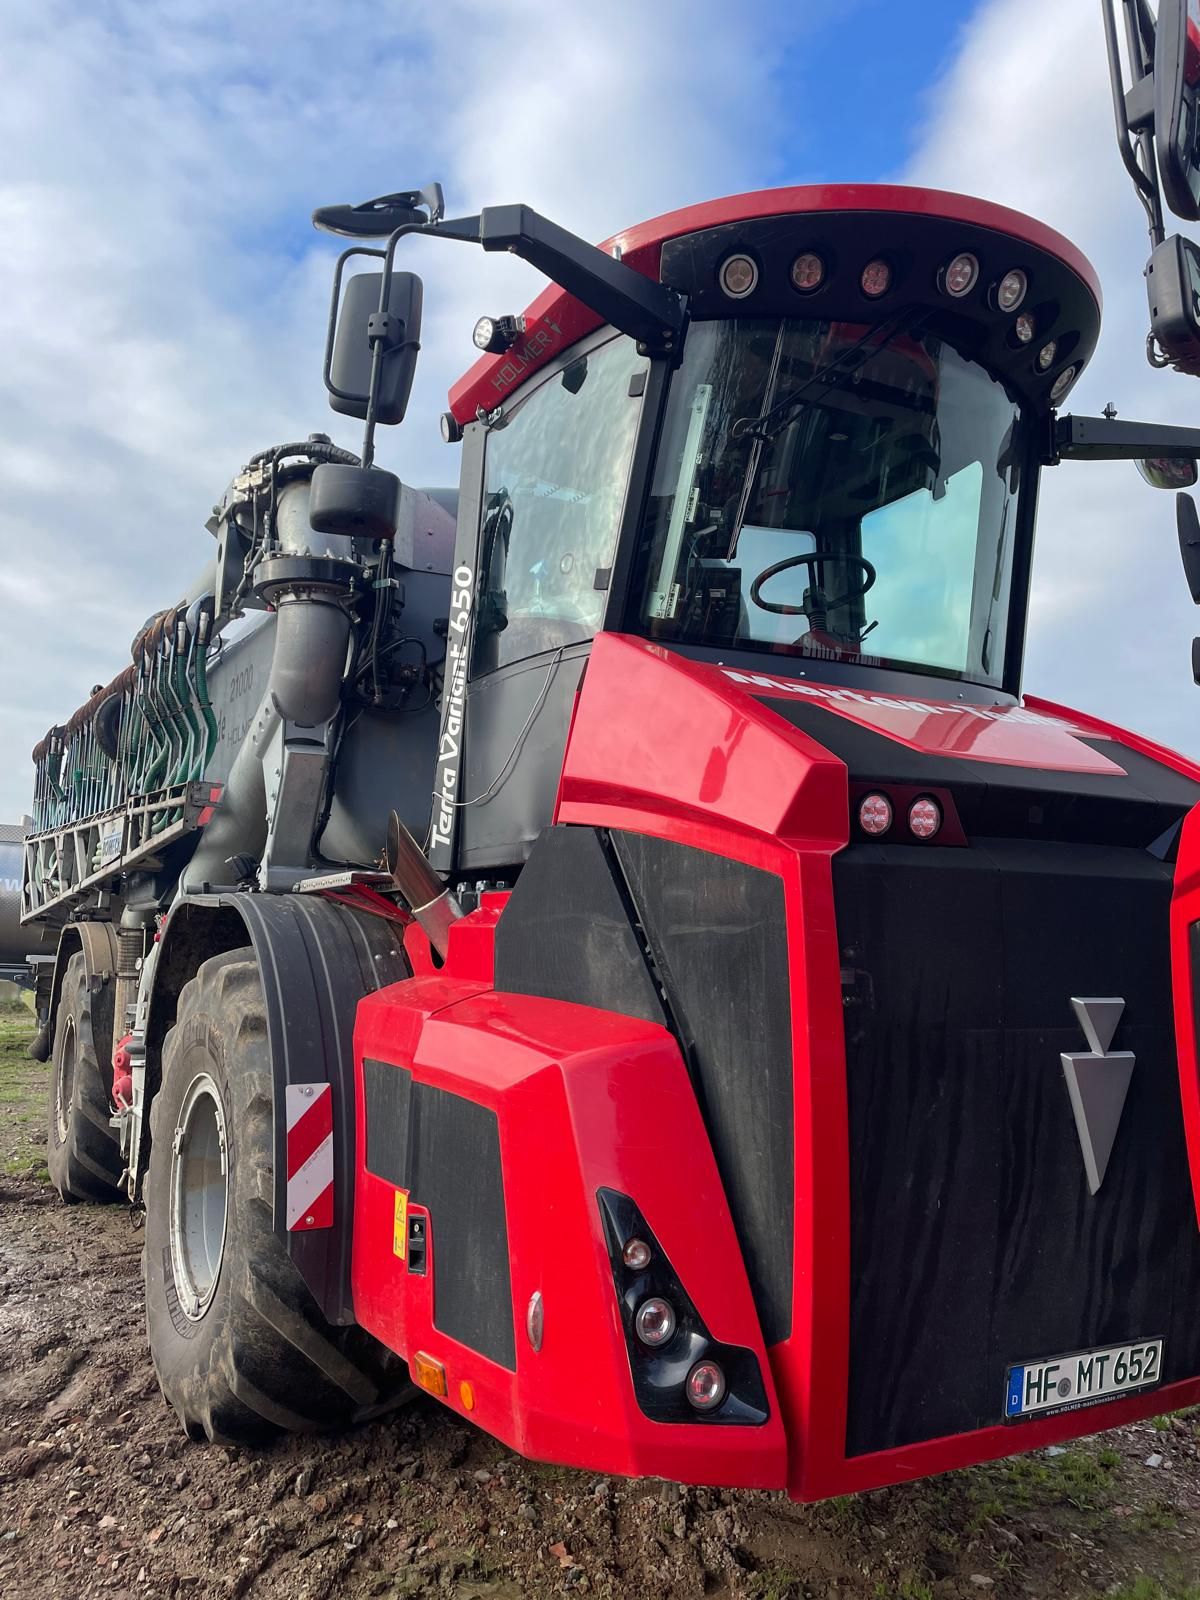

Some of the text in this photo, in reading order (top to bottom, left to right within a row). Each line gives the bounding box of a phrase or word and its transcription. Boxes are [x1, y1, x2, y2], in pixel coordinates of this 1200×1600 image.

[491, 330, 552, 392] HOLMER
[230, 663, 254, 703] 21000
[431, 566, 473, 848] Terra Variant 650
[1012, 1345, 1158, 1406] D HF MT 652
